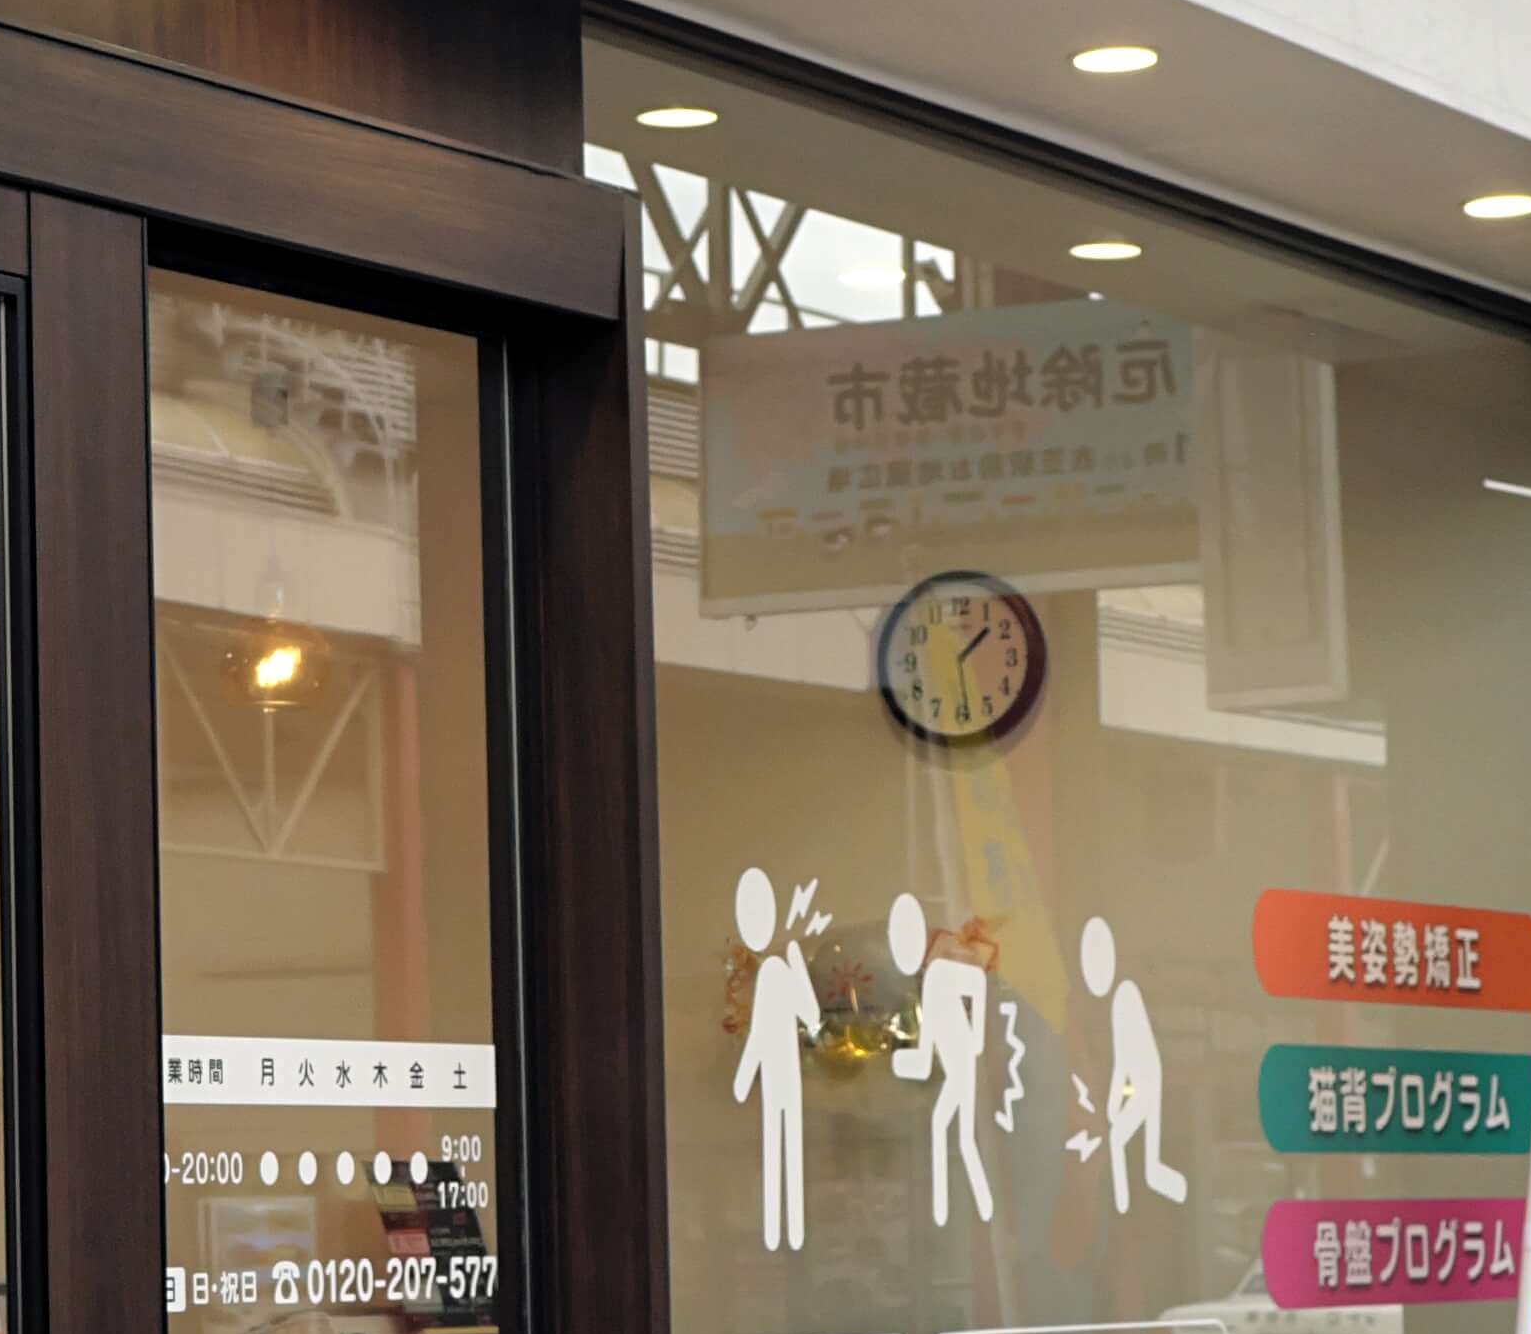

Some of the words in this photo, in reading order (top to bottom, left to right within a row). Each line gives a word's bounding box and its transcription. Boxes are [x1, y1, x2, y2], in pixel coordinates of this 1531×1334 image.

[1328, 915, 1482, 991] 美姿勢矯正
[260, 1058, 276, 1087] 月
[298, 1058, 315, 1088] 火
[335, 1059, 352, 1089] 水
[373, 1060, 389, 1089] 木
[409, 1061, 425, 1090] 金
[452, 1062, 468, 1090] 土
[1308, 1067, 1511, 1134] 猫背プログラム
[441, 1135, 482, 1163] 9:00
[437, 1181, 489, 1210] 17:00
[1313, 1221, 1515, 1289] 骨盤プログラム
